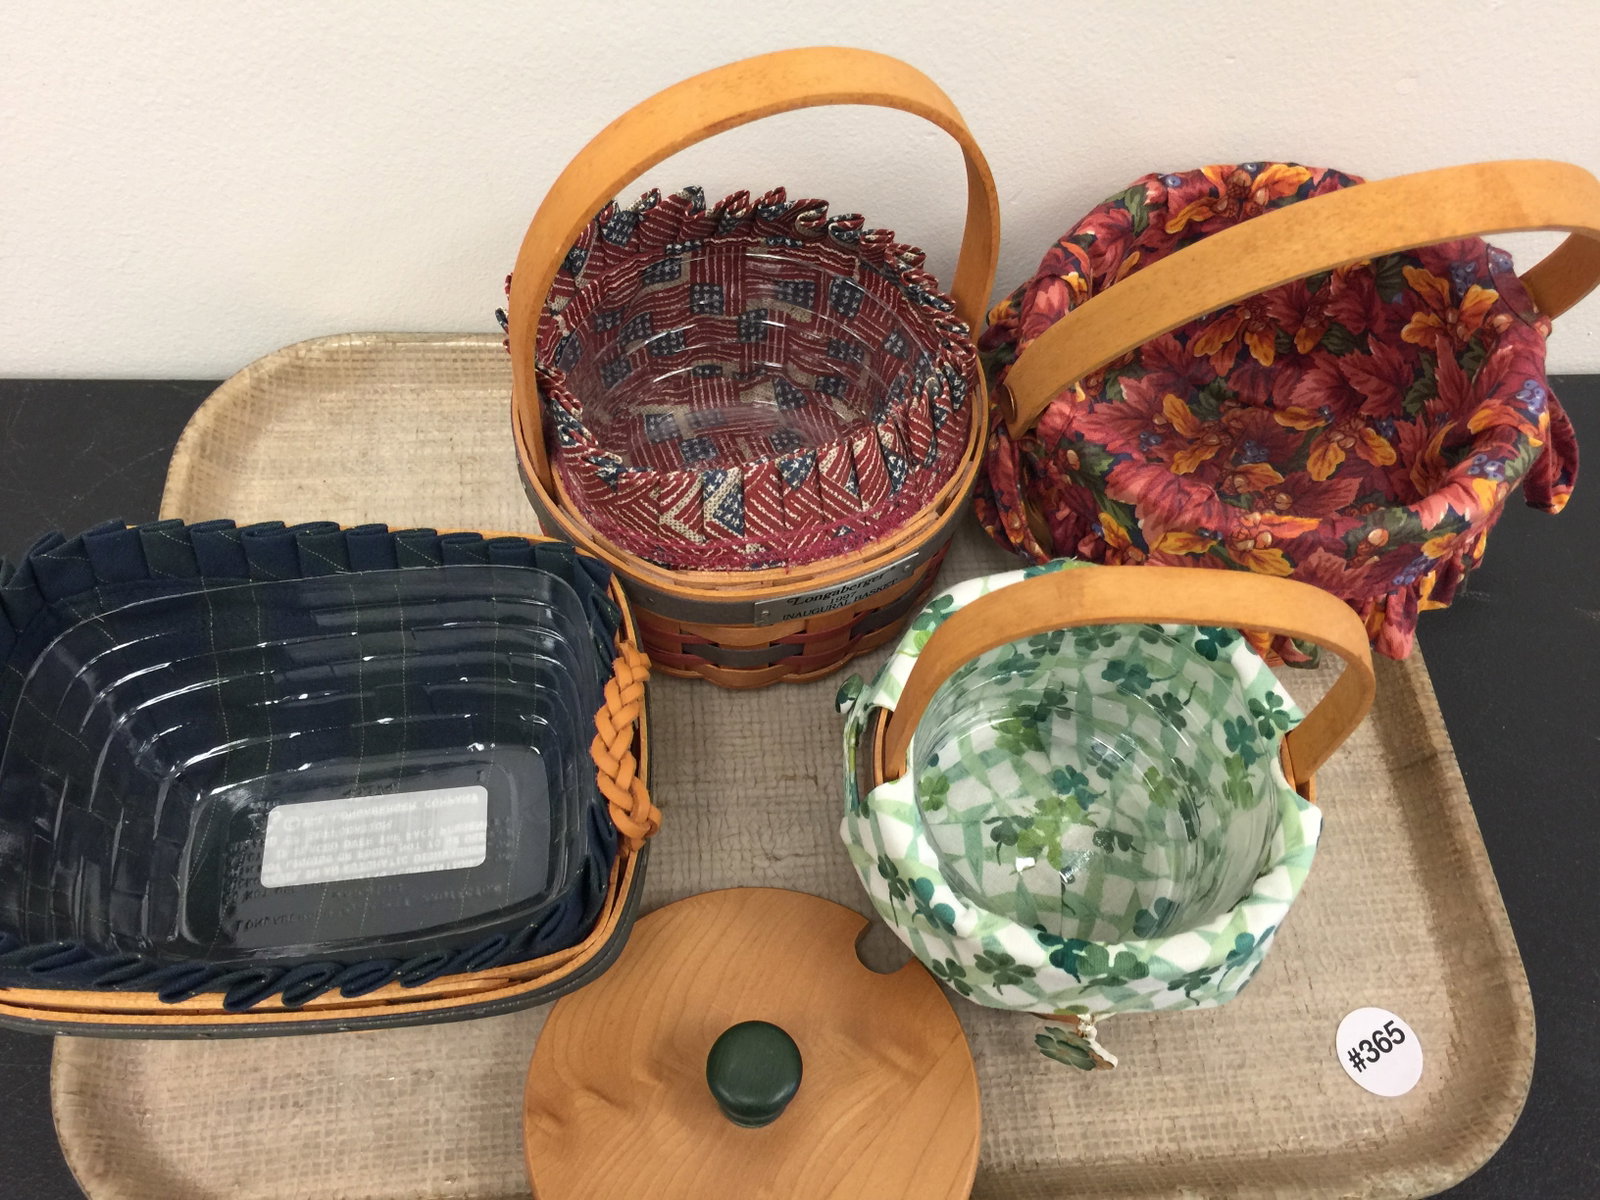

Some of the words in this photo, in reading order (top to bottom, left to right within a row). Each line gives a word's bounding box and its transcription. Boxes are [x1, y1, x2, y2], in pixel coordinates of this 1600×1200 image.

[782, 600, 850, 621] INAUGURAL
[854, 578, 899, 602] BASKET
[787, 572, 884, 606] Longaberger
[829, 592, 856, 604] 1997
[1347, 1020, 1406, 1073] #365
